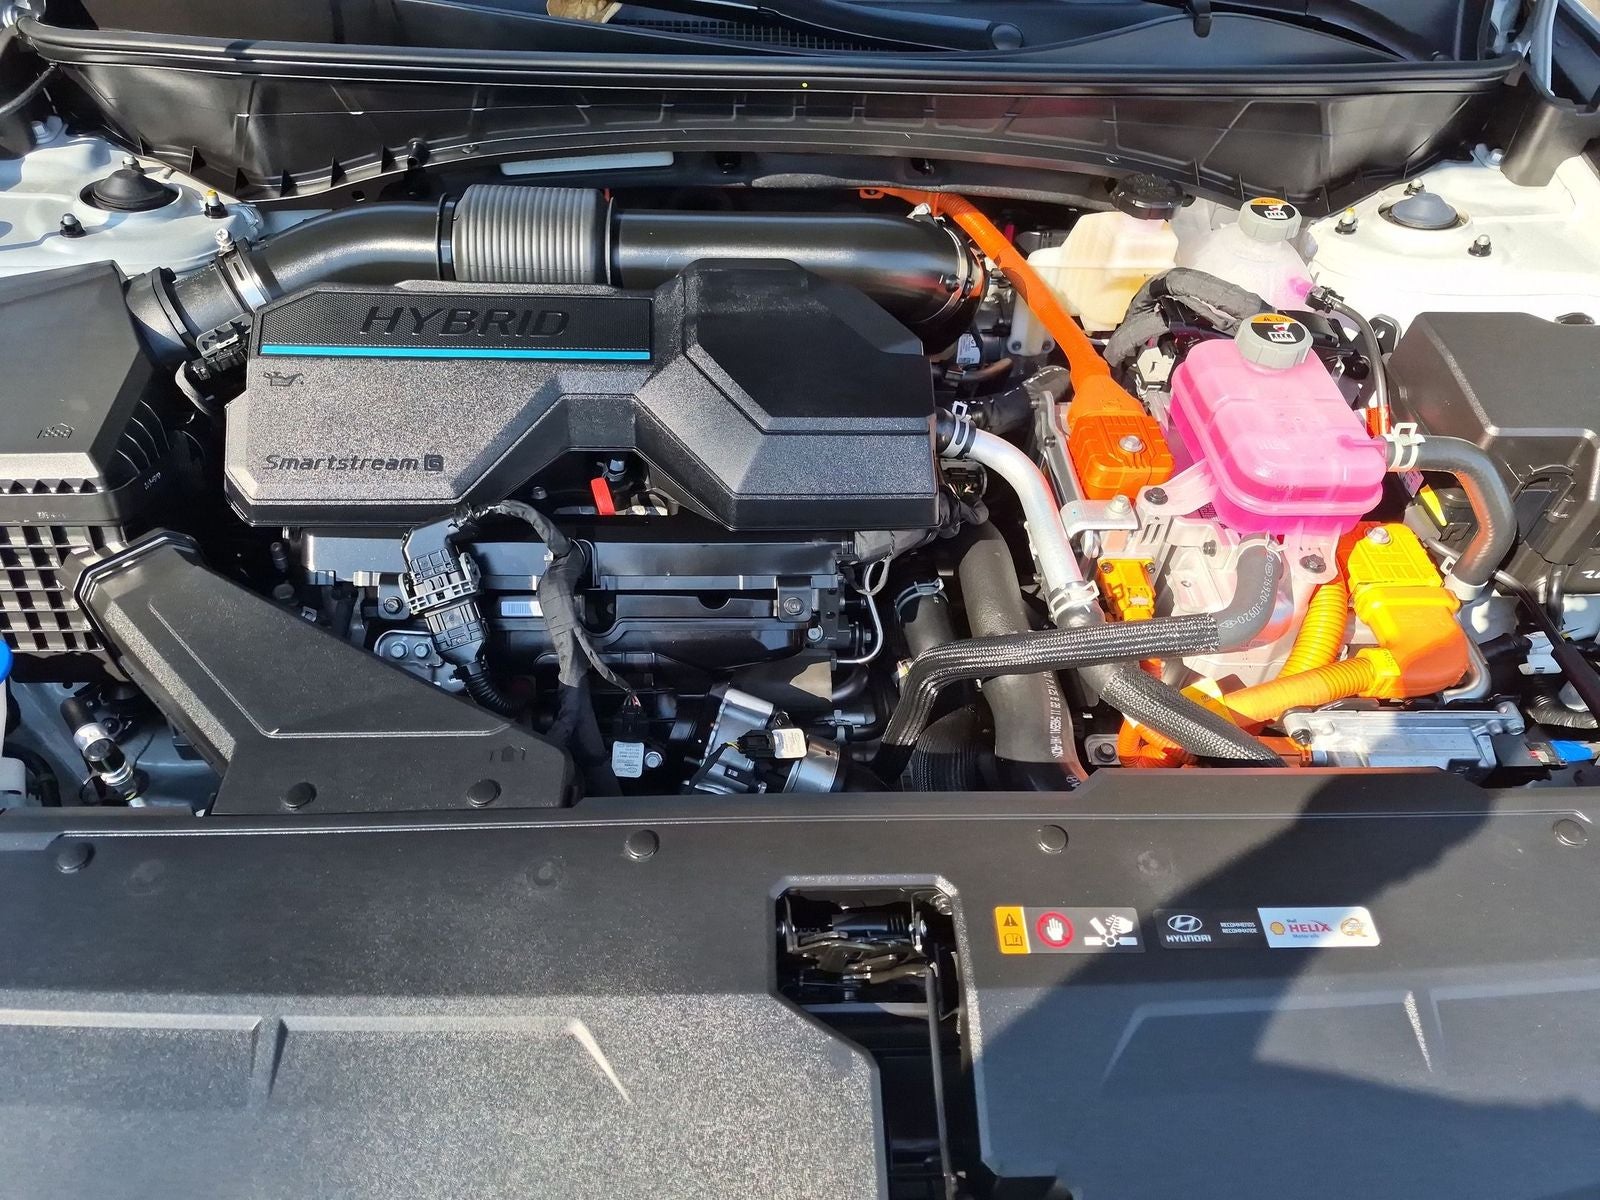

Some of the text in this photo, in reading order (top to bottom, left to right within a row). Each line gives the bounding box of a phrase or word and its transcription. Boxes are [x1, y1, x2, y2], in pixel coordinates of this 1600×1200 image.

[359, 305, 570, 339] HYBRID
[262, 453, 419, 473] Smartstream
[1288, 922, 1333, 933] HELIX
[1165, 934, 1212, 943] HYUNDAI
